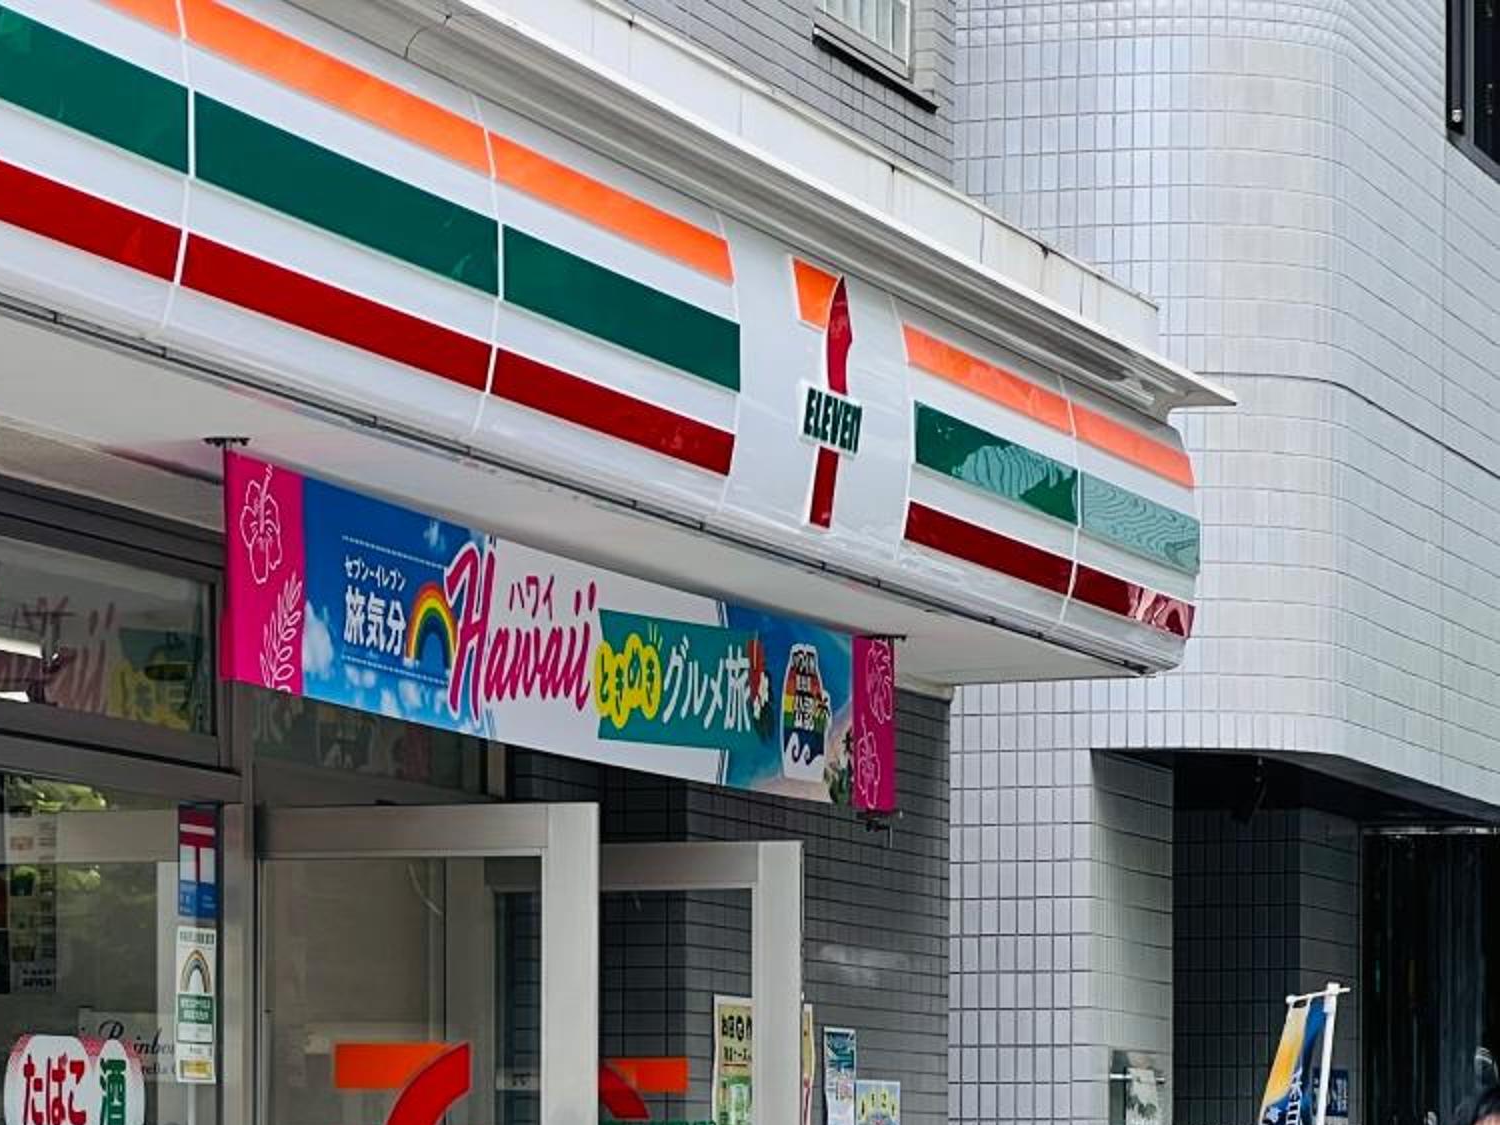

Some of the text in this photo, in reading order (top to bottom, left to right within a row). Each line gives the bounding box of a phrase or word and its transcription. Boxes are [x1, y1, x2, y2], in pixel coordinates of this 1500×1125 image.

[344, 586, 406, 654] 旅気分
[445, 544, 596, 720] Hawaii
[509, 576, 555, 620] ハワイ
[663, 635, 750, 732] グルメ旅
